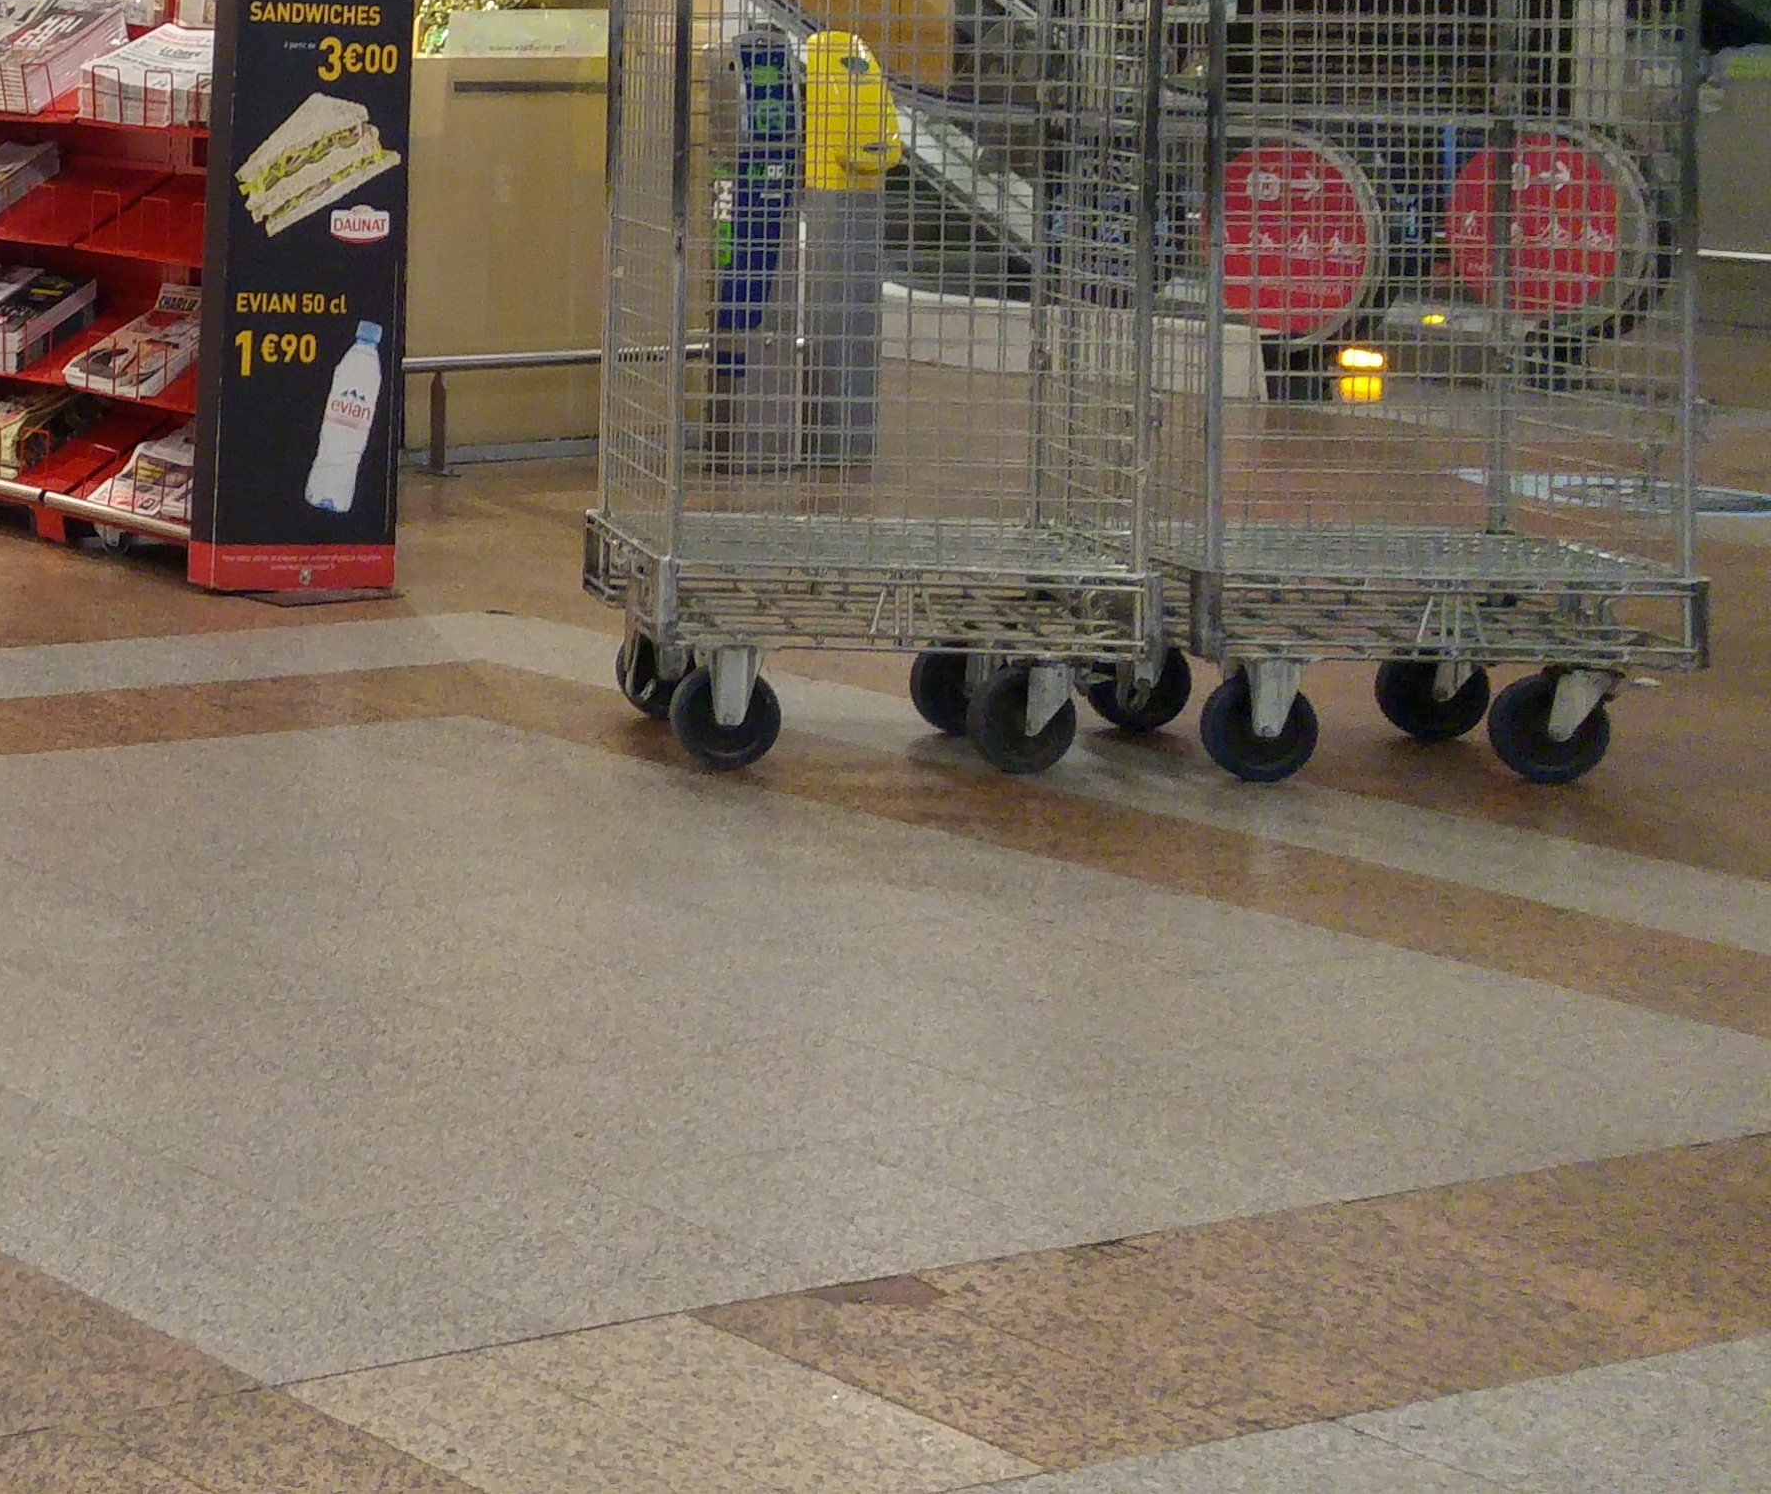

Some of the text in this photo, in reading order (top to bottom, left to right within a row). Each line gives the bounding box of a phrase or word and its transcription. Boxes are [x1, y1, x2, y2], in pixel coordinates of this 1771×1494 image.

[250, 1, 381, 26] SANDWICHES
[318, 36, 399, 81] 3€00
[333, 217, 387, 233] DAUNAT
[159, 294, 200, 312] CHARLIE
[235, 292, 348, 314] EVIAN 50 cl
[330, 397, 371, 420] evian
